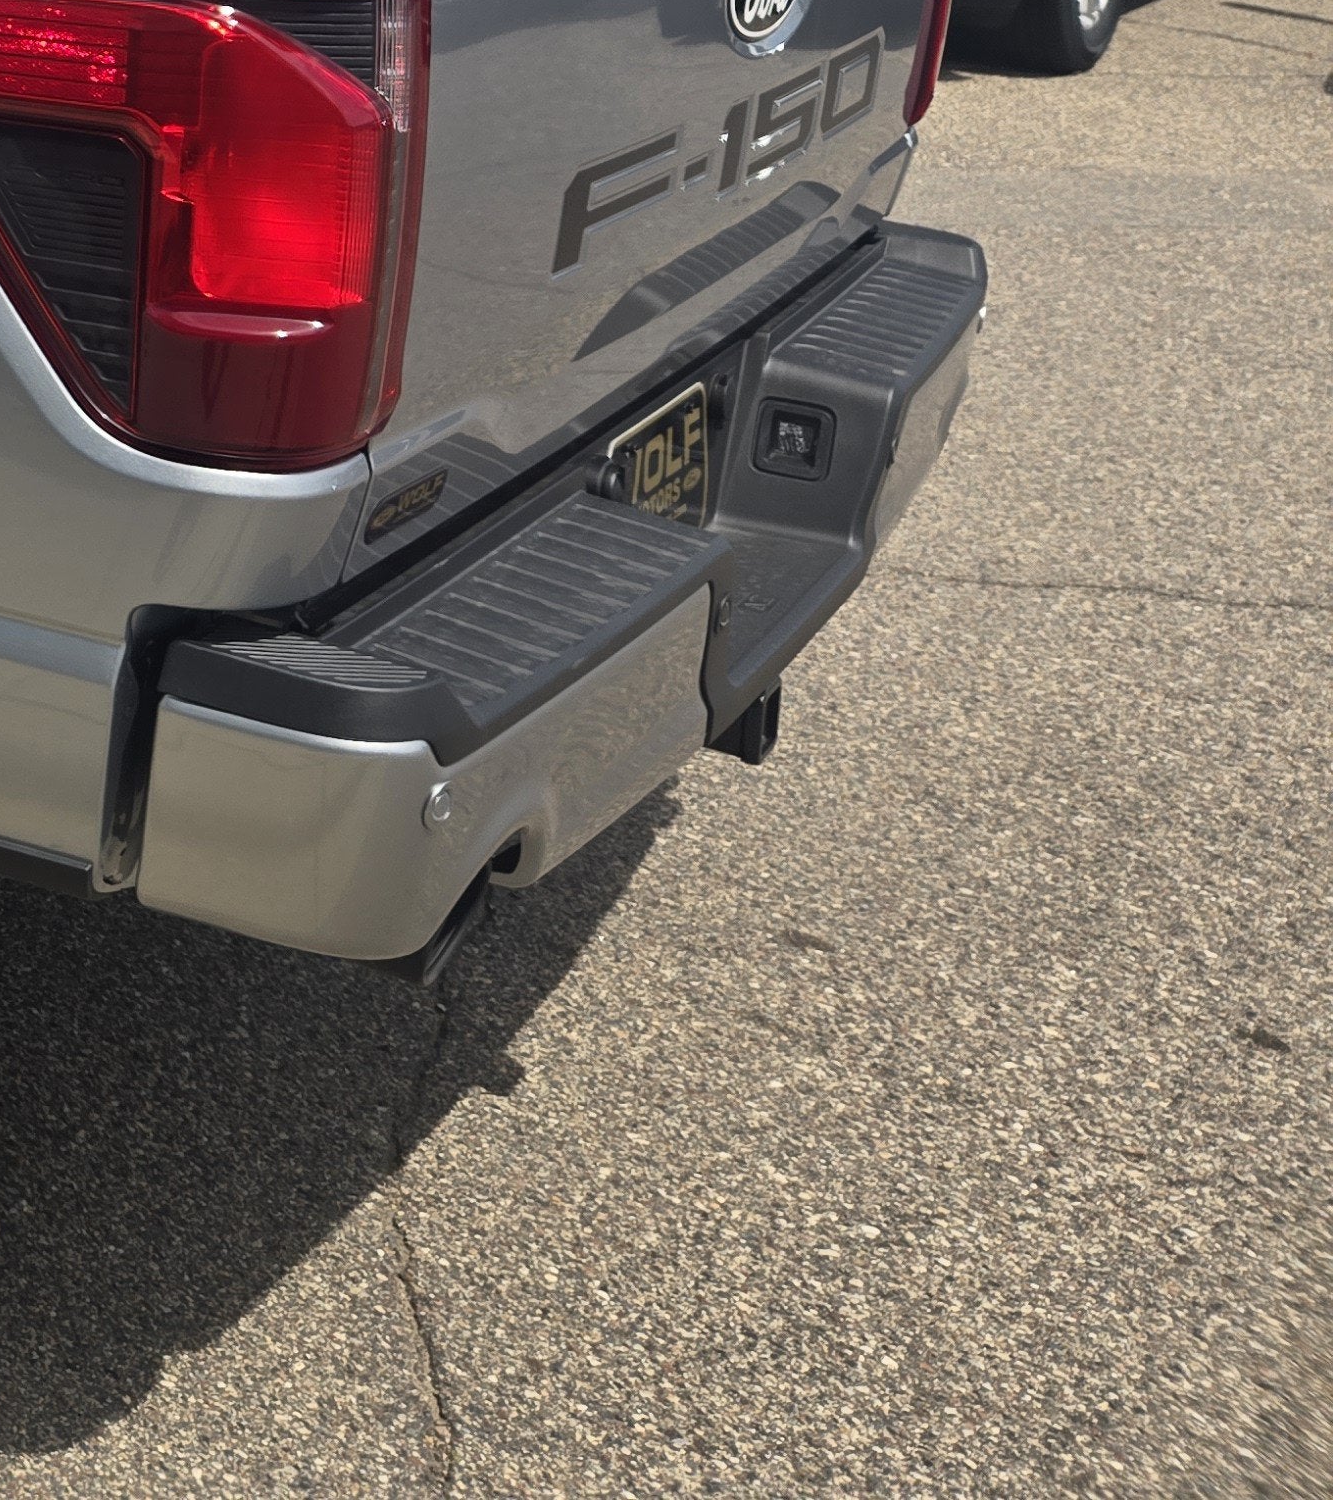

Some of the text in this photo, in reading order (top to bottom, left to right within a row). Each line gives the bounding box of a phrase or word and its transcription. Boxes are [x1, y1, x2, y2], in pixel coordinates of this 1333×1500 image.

[552, 27, 886, 280] F-150
[397, 472, 445, 512] WOLF
[631, 407, 702, 505] OLF
